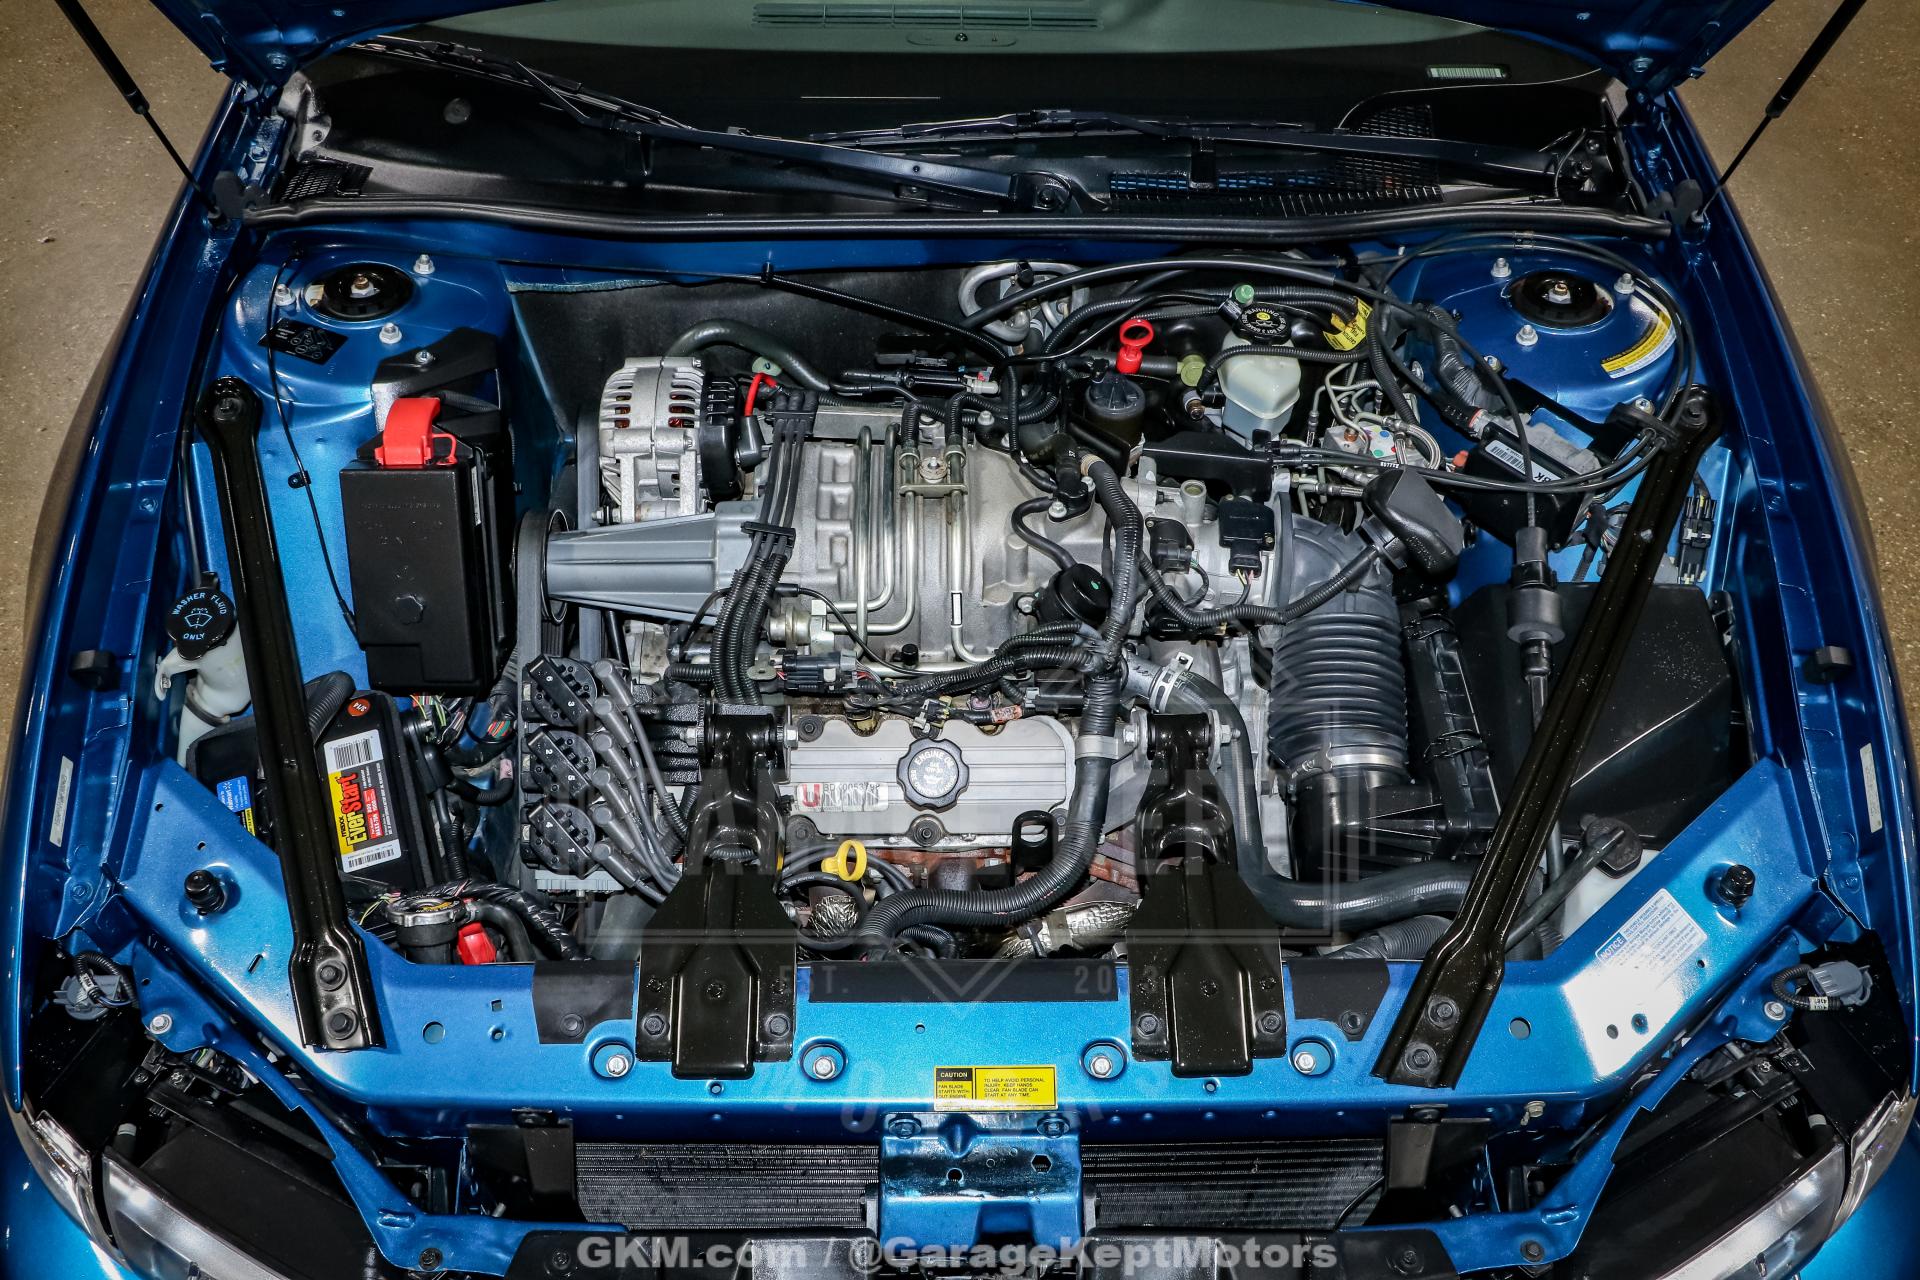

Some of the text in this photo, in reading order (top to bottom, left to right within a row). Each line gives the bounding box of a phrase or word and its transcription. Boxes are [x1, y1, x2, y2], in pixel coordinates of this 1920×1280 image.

[171, 592, 227, 615] WASHER FLUID
[914, 750, 945, 765] ENGINE
[336, 772, 370, 847] EverStart
[1599, 936, 1625, 960] NOTICE
